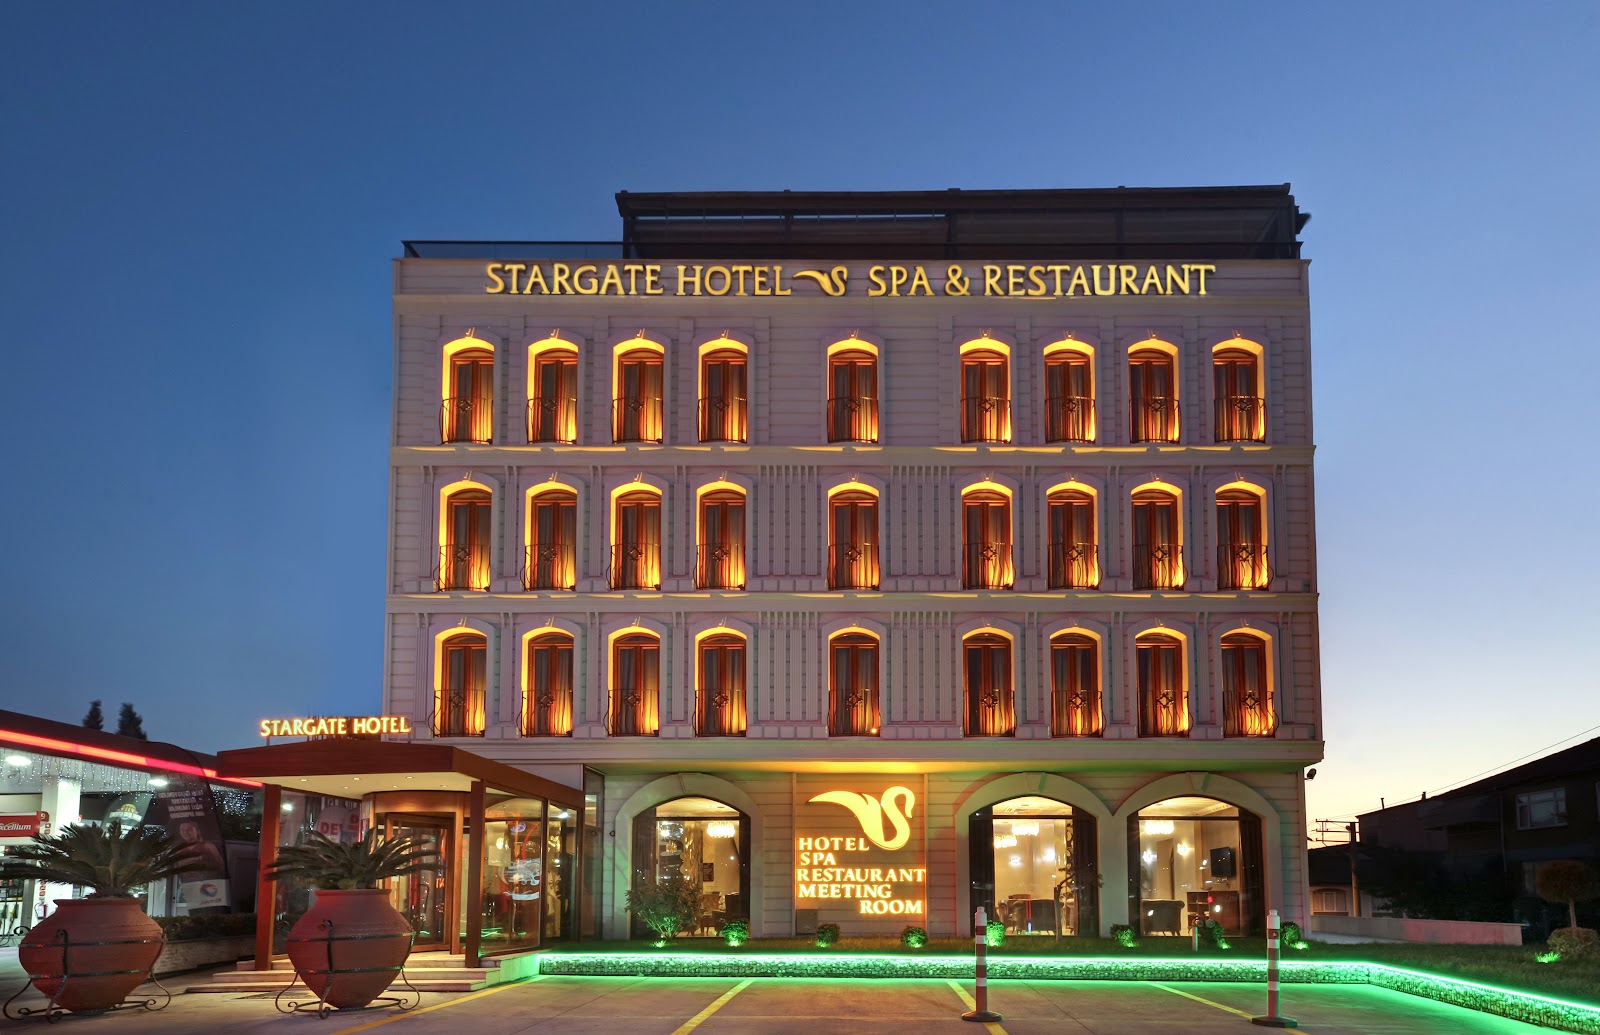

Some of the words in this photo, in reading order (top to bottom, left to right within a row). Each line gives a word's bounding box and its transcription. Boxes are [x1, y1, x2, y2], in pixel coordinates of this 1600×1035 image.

[485, 263, 664, 295] STARGATE
[676, 265, 792, 297] HOTEL
[867, 265, 935, 297] SPA
[945, 264, 971, 297] &
[983, 264, 1216, 297] RESTAURANT
[260, 718, 347, 737] STARGATE
[353, 717, 411, 735] HOTEL
[798, 836, 870, 851] HOTEL
[800, 851, 836, 866] SPA
[796, 868, 926, 882] RESTAURANT
[798, 883, 892, 899] MEETING
[860, 899, 923, 915] ROOM
